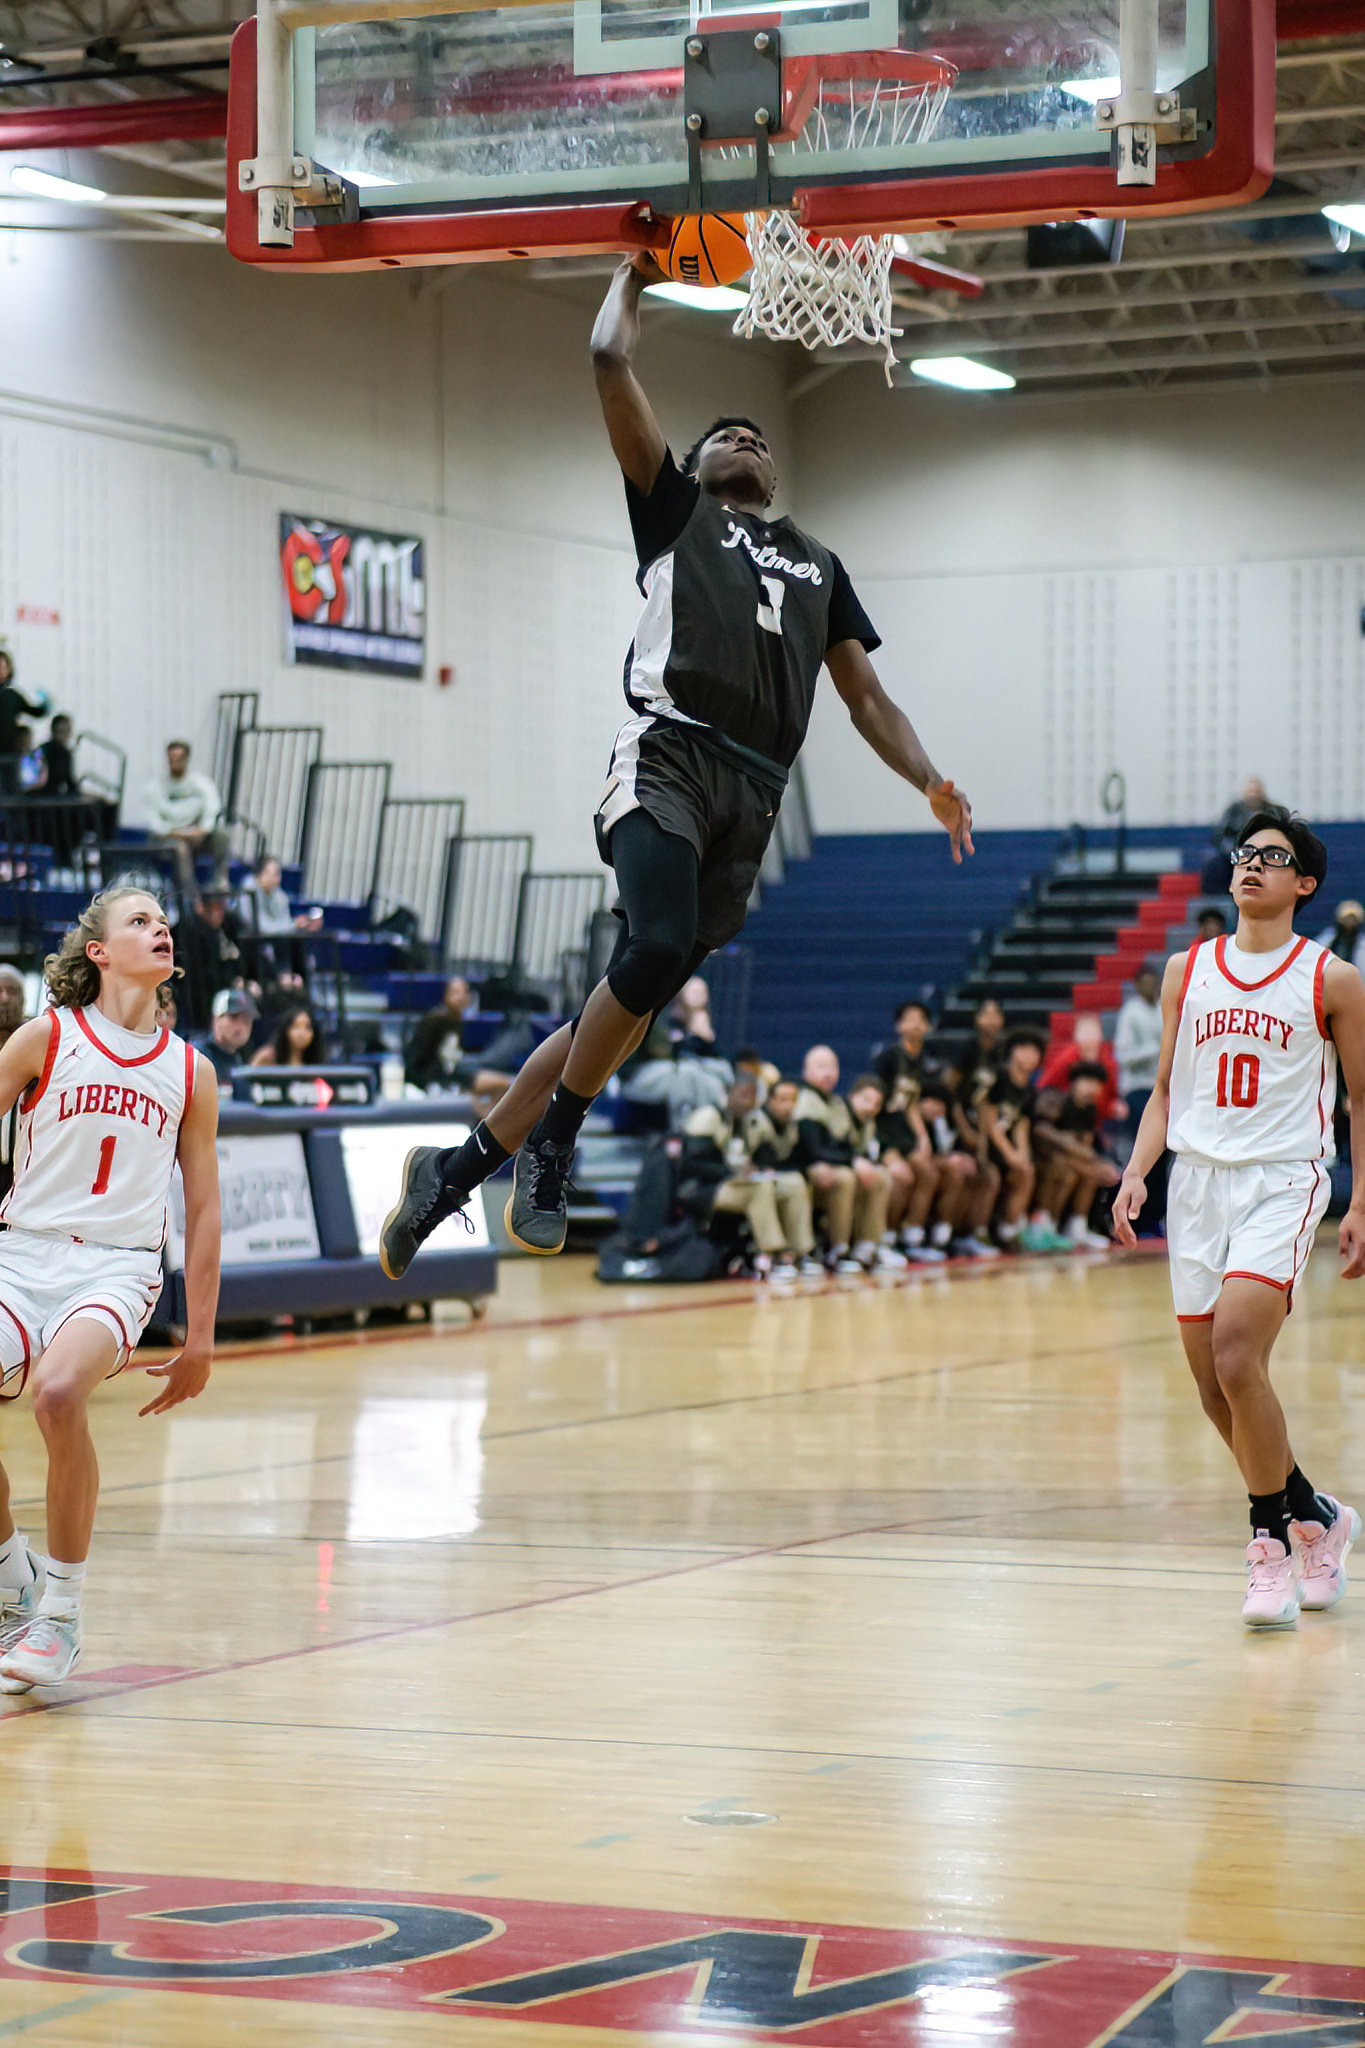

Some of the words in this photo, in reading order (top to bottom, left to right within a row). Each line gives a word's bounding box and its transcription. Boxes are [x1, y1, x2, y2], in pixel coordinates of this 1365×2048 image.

[1195, 1008, 1294, 1051] LIBERTY
[1216, 1052, 1260, 1109] 10
[58, 1084, 168, 1139] LIBERTY
[91, 1135, 117, 1195] 1
